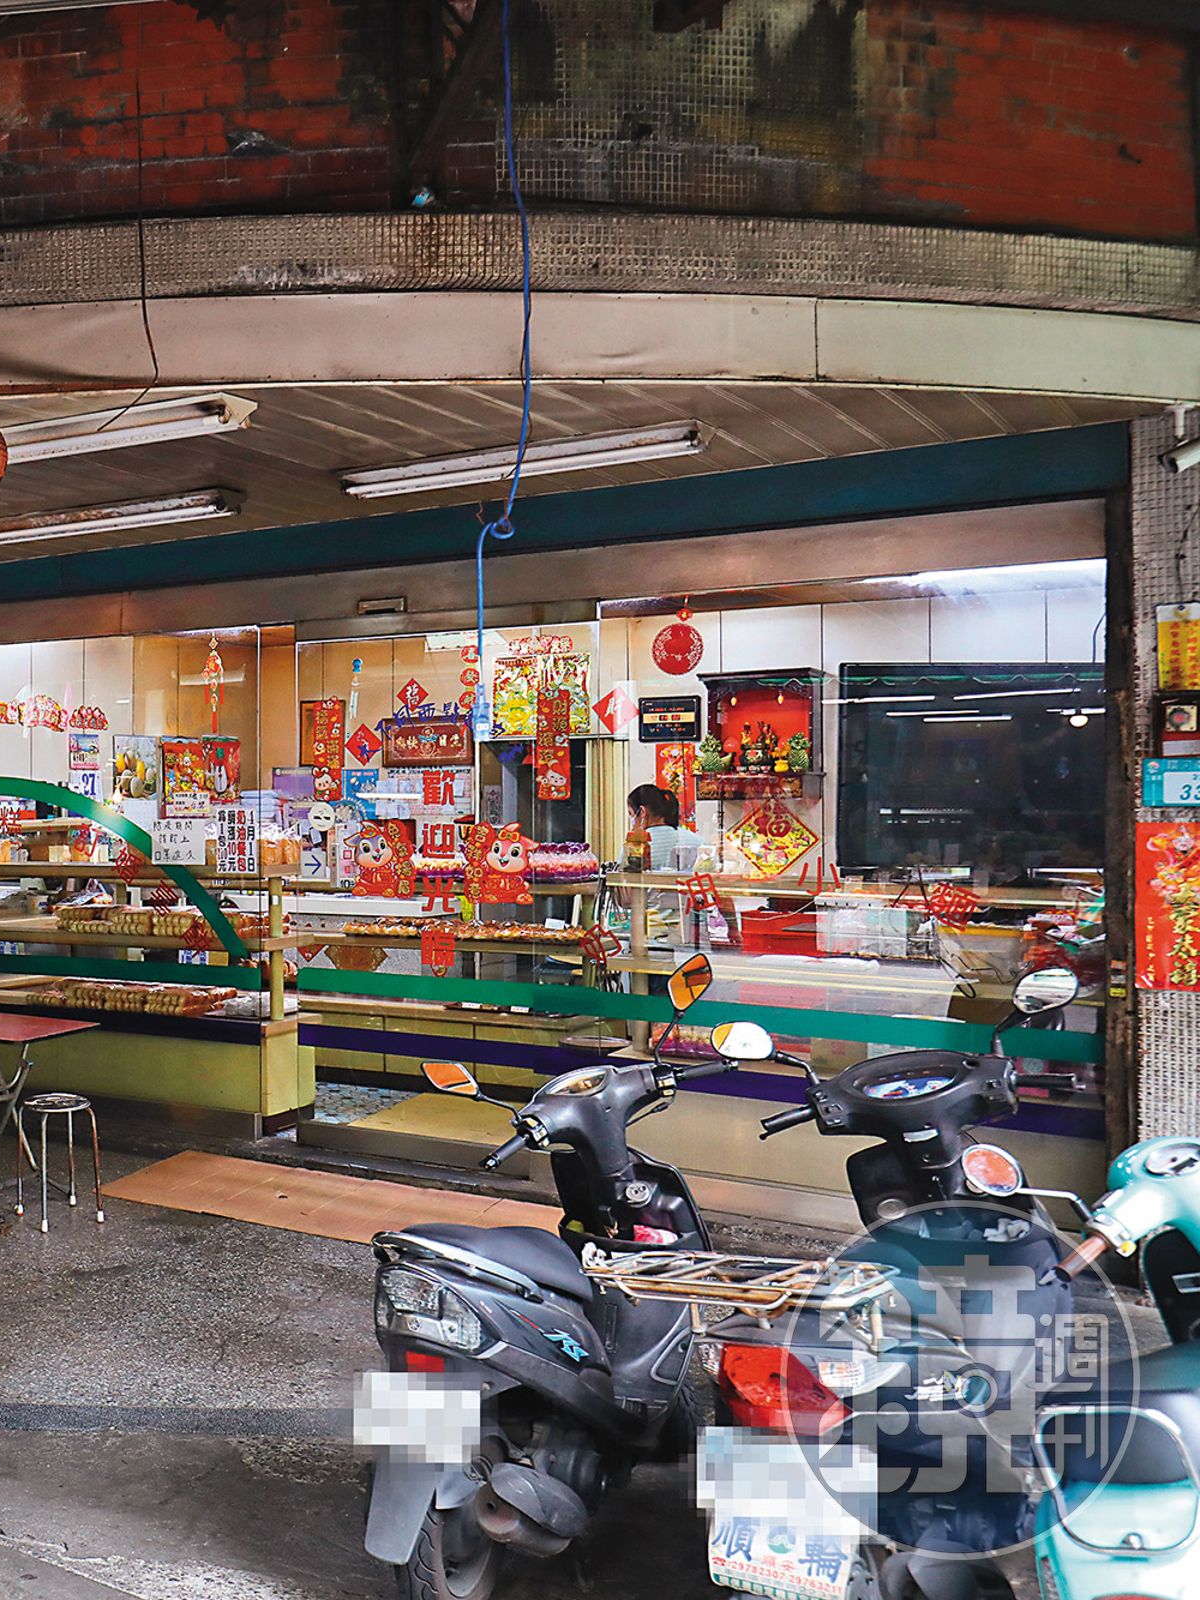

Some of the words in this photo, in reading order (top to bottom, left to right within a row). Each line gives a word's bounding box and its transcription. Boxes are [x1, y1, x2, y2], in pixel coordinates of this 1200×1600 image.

[81, 773, 96, 796] 27
[421, 769, 456, 967] 歡迎光臨
